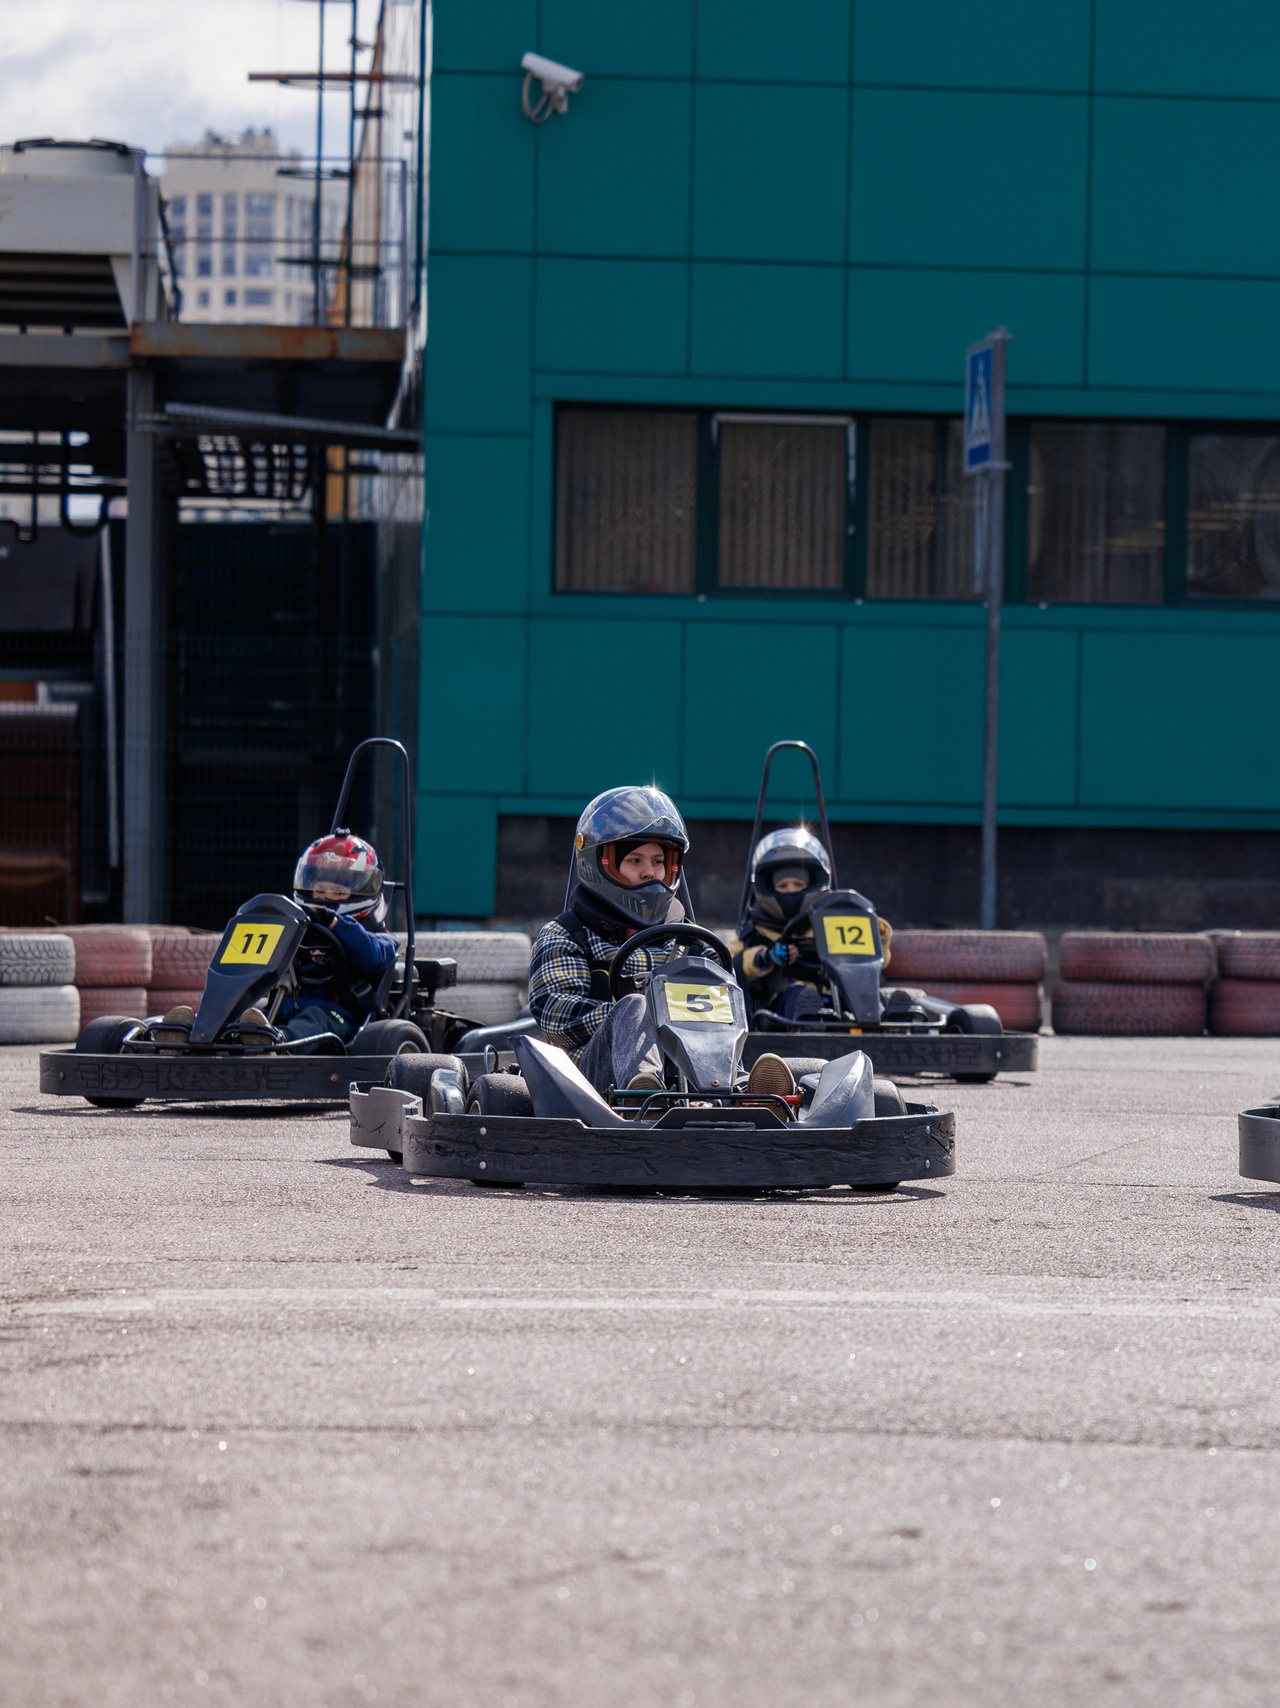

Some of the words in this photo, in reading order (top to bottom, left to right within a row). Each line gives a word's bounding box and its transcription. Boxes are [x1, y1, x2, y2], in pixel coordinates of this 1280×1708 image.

[241, 933, 269, 954] 11
[835, 926, 866, 946] 12
[686, 993, 713, 1013] 5
